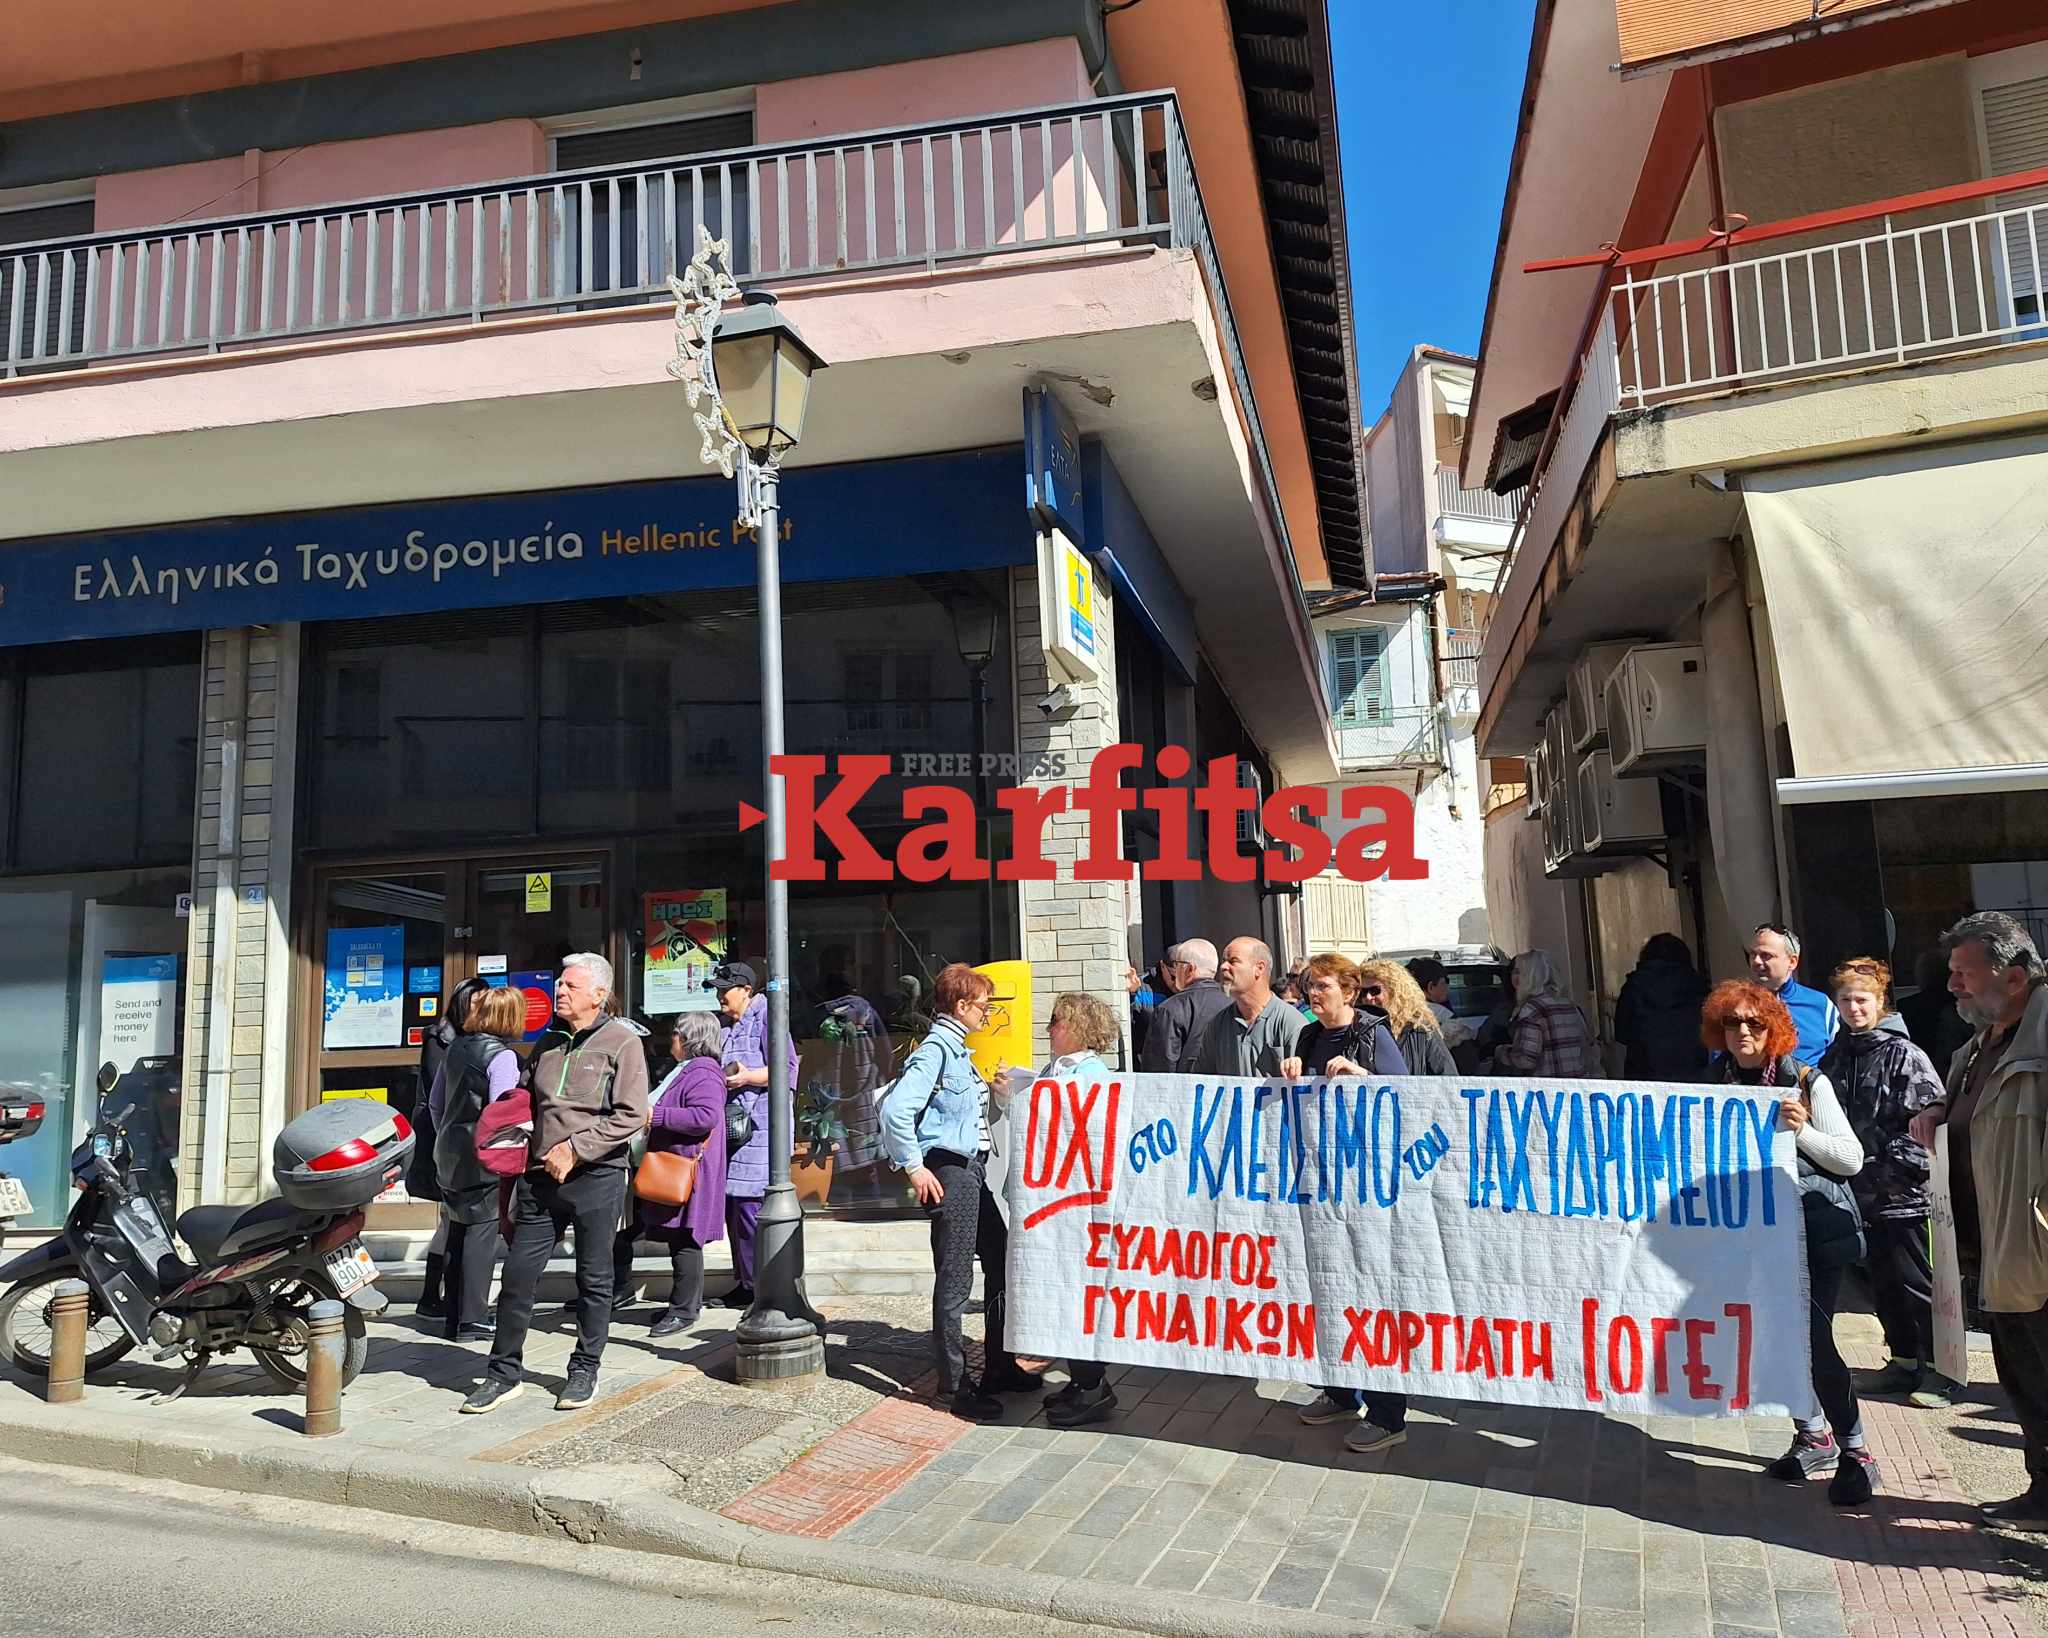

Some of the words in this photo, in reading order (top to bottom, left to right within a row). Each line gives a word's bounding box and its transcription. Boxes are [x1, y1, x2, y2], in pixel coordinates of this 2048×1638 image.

[602, 523, 721, 556] Hellenic
[74, 546, 279, 604] Ελληνικά
[296, 521, 583, 590] Ταχυδρομεία
[115, 1000, 141, 1009] Send
[142, 998, 162, 1008] and
[115, 1011, 152, 1020] receive
[113, 1034, 137, 1042] here
[114, 1023, 148, 1032] money
[1023, 1079, 1122, 1192] ΟΧΙ
[1187, 1083, 1401, 1209] ΚΛΕΙΣΙΜΟ
[1460, 1089, 1783, 1230] ΤΑΧΥΔΡΟΜΕΙΟΥ
[1085, 1222, 1278, 1290] ΣΥΛΛΟΓΟΣ
[1083, 1285, 1316, 1361] ΓΥΝΑΙΚΩΝ
[1340, 1305, 1554, 1382] ΧΟΡΤΙΑΤΗ
